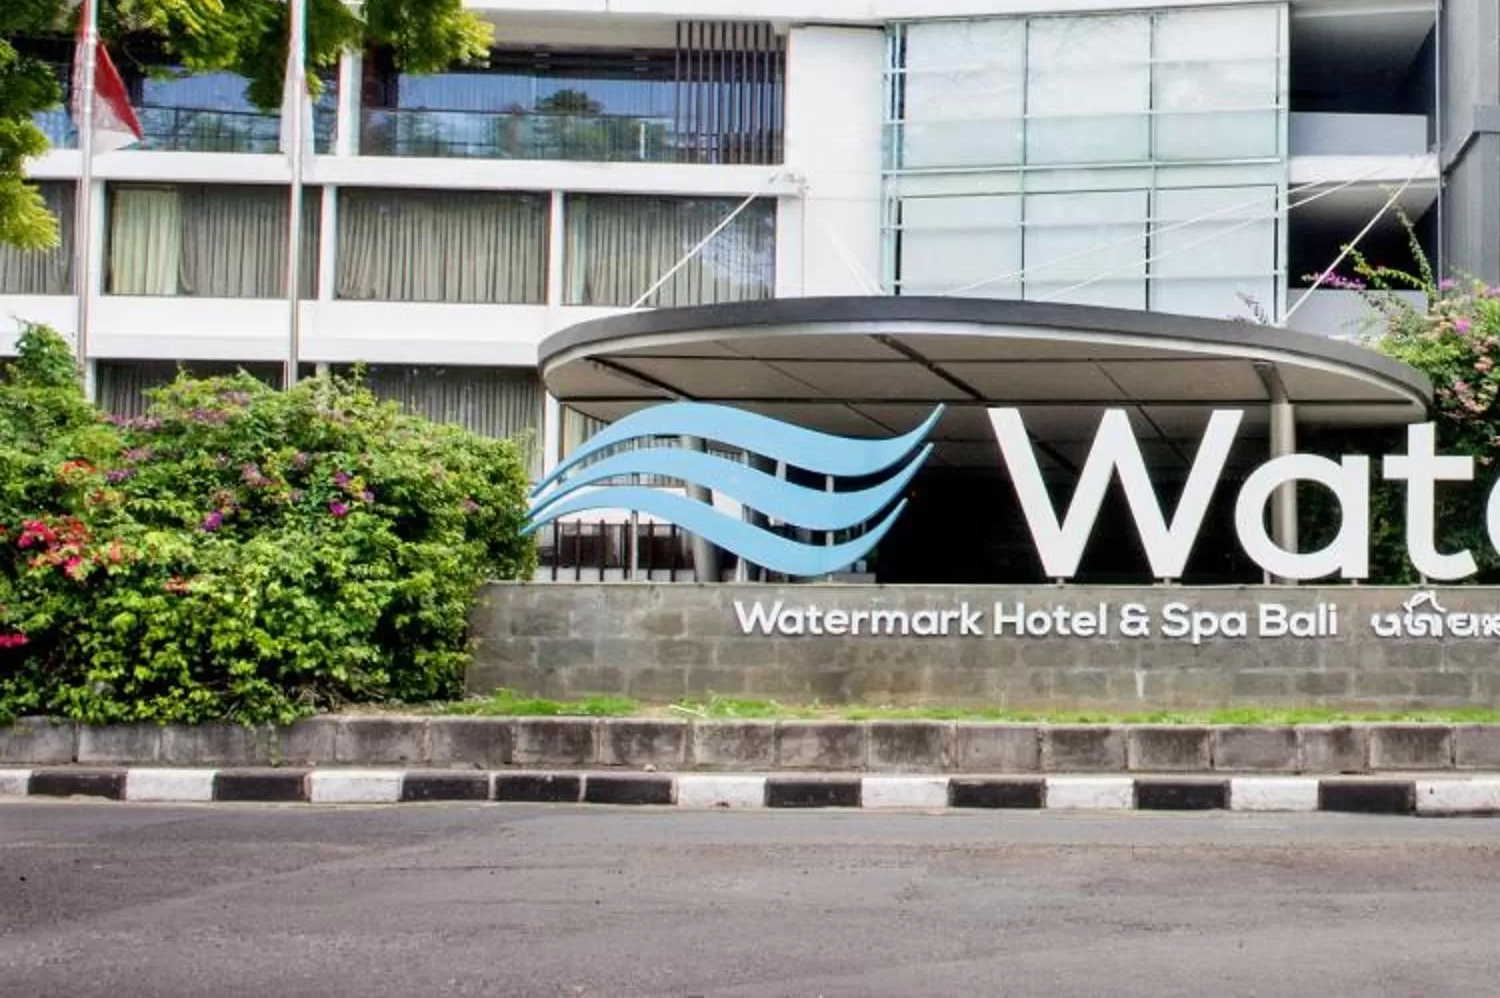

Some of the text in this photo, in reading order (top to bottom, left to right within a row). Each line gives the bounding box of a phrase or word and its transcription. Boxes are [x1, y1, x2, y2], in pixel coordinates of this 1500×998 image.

[733, 599, 1338, 645] Watermark Hotel & Spa Bali
